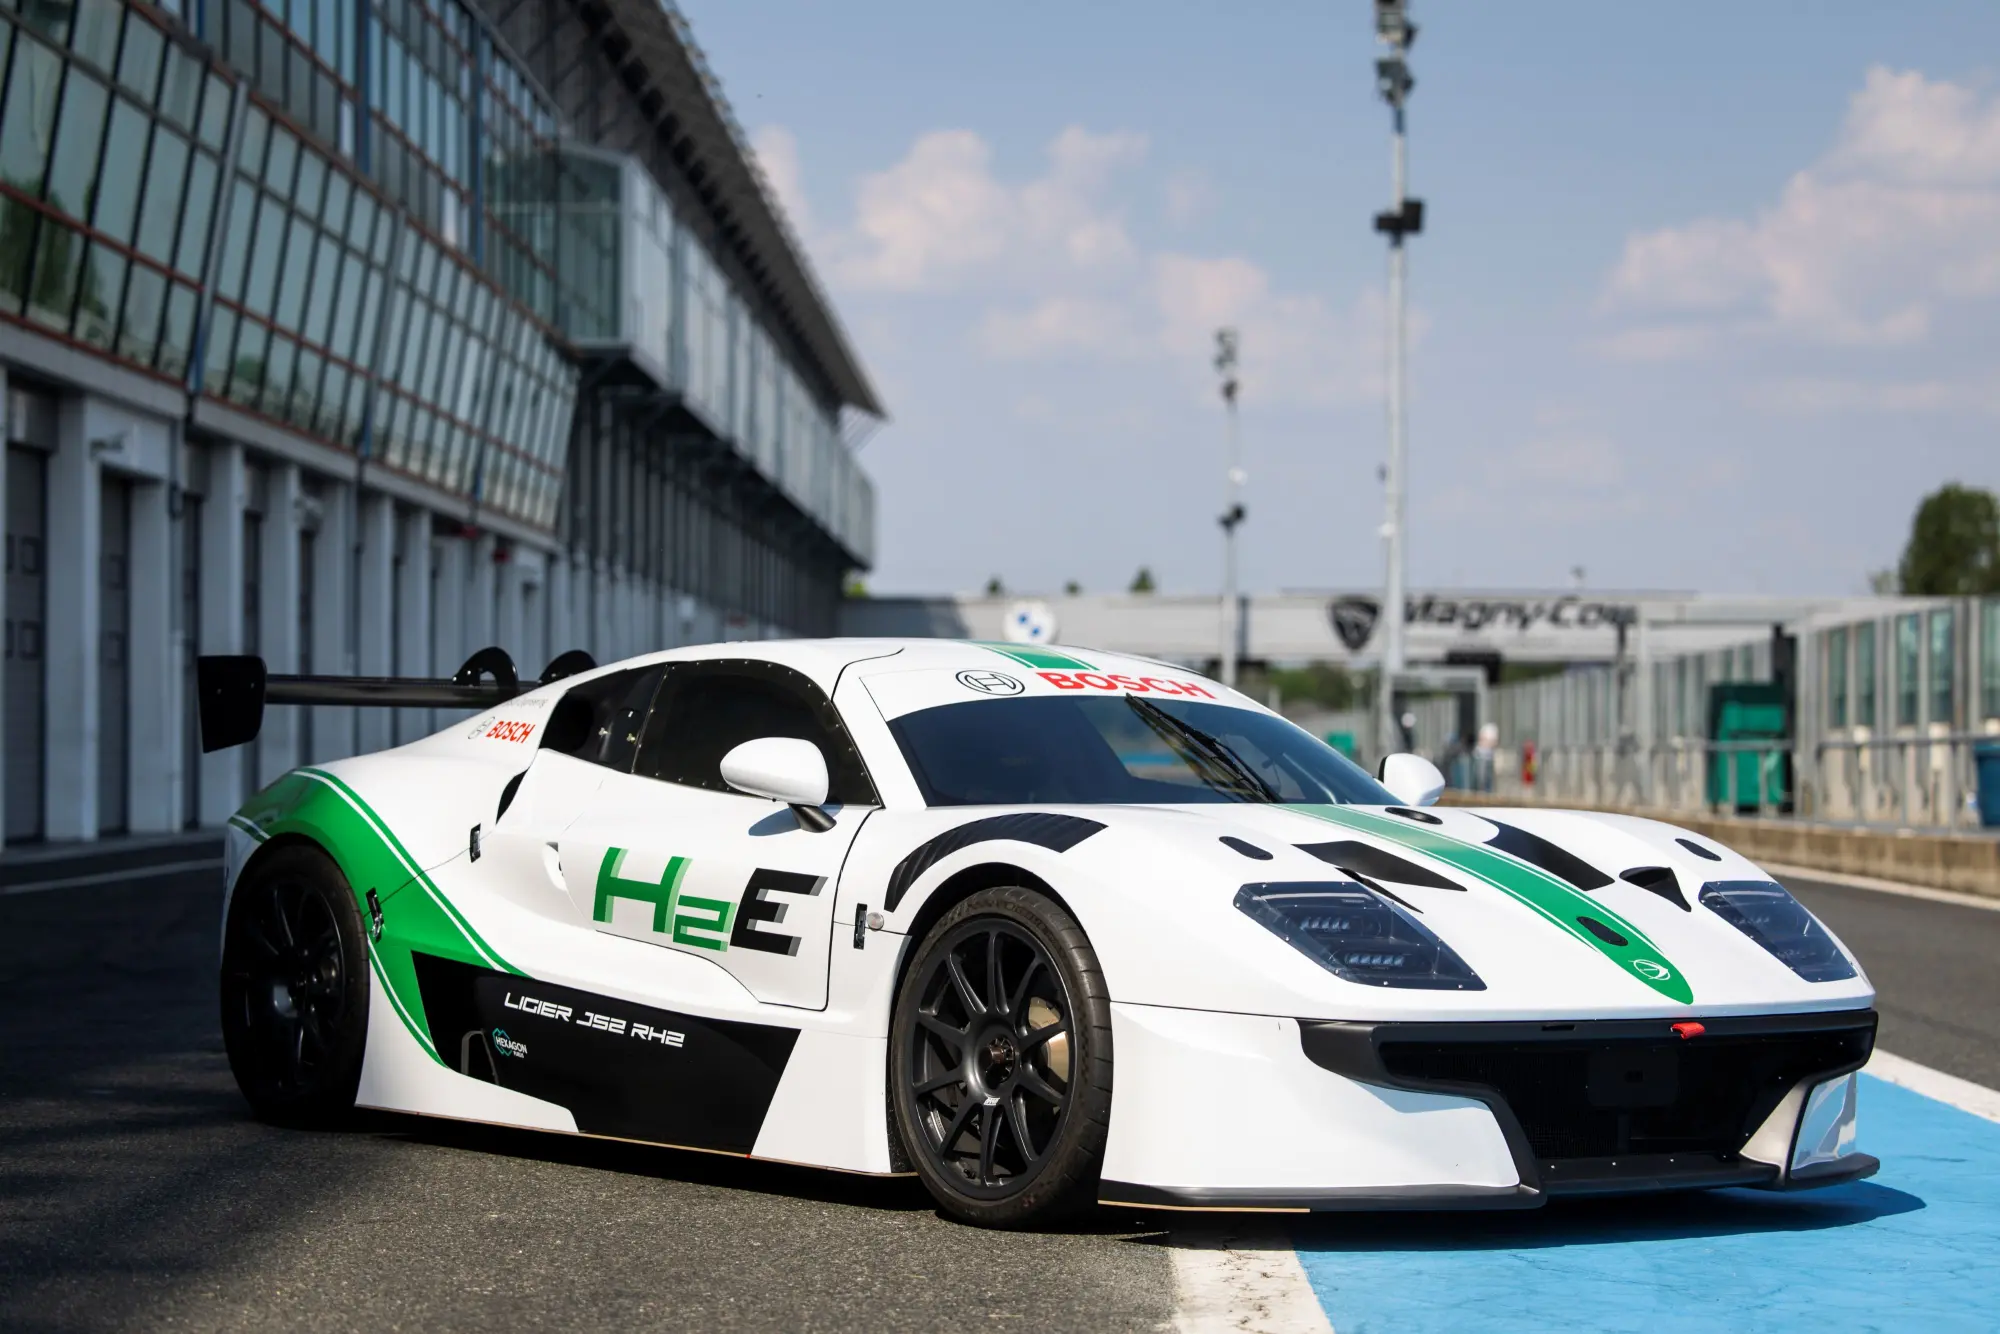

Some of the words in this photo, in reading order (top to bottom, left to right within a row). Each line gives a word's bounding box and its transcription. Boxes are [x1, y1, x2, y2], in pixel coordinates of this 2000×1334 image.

[1036, 671, 1217, 699] BOSCH
[486, 720, 536, 743] BOSCH
[593, 846, 829, 957] H2E
[504, 992, 573, 1022] LIGIER
[576, 1011, 626, 1034] JS2
[630, 1022, 686, 1048] RH2
[495, 1036, 528, 1054] HEXAGON
